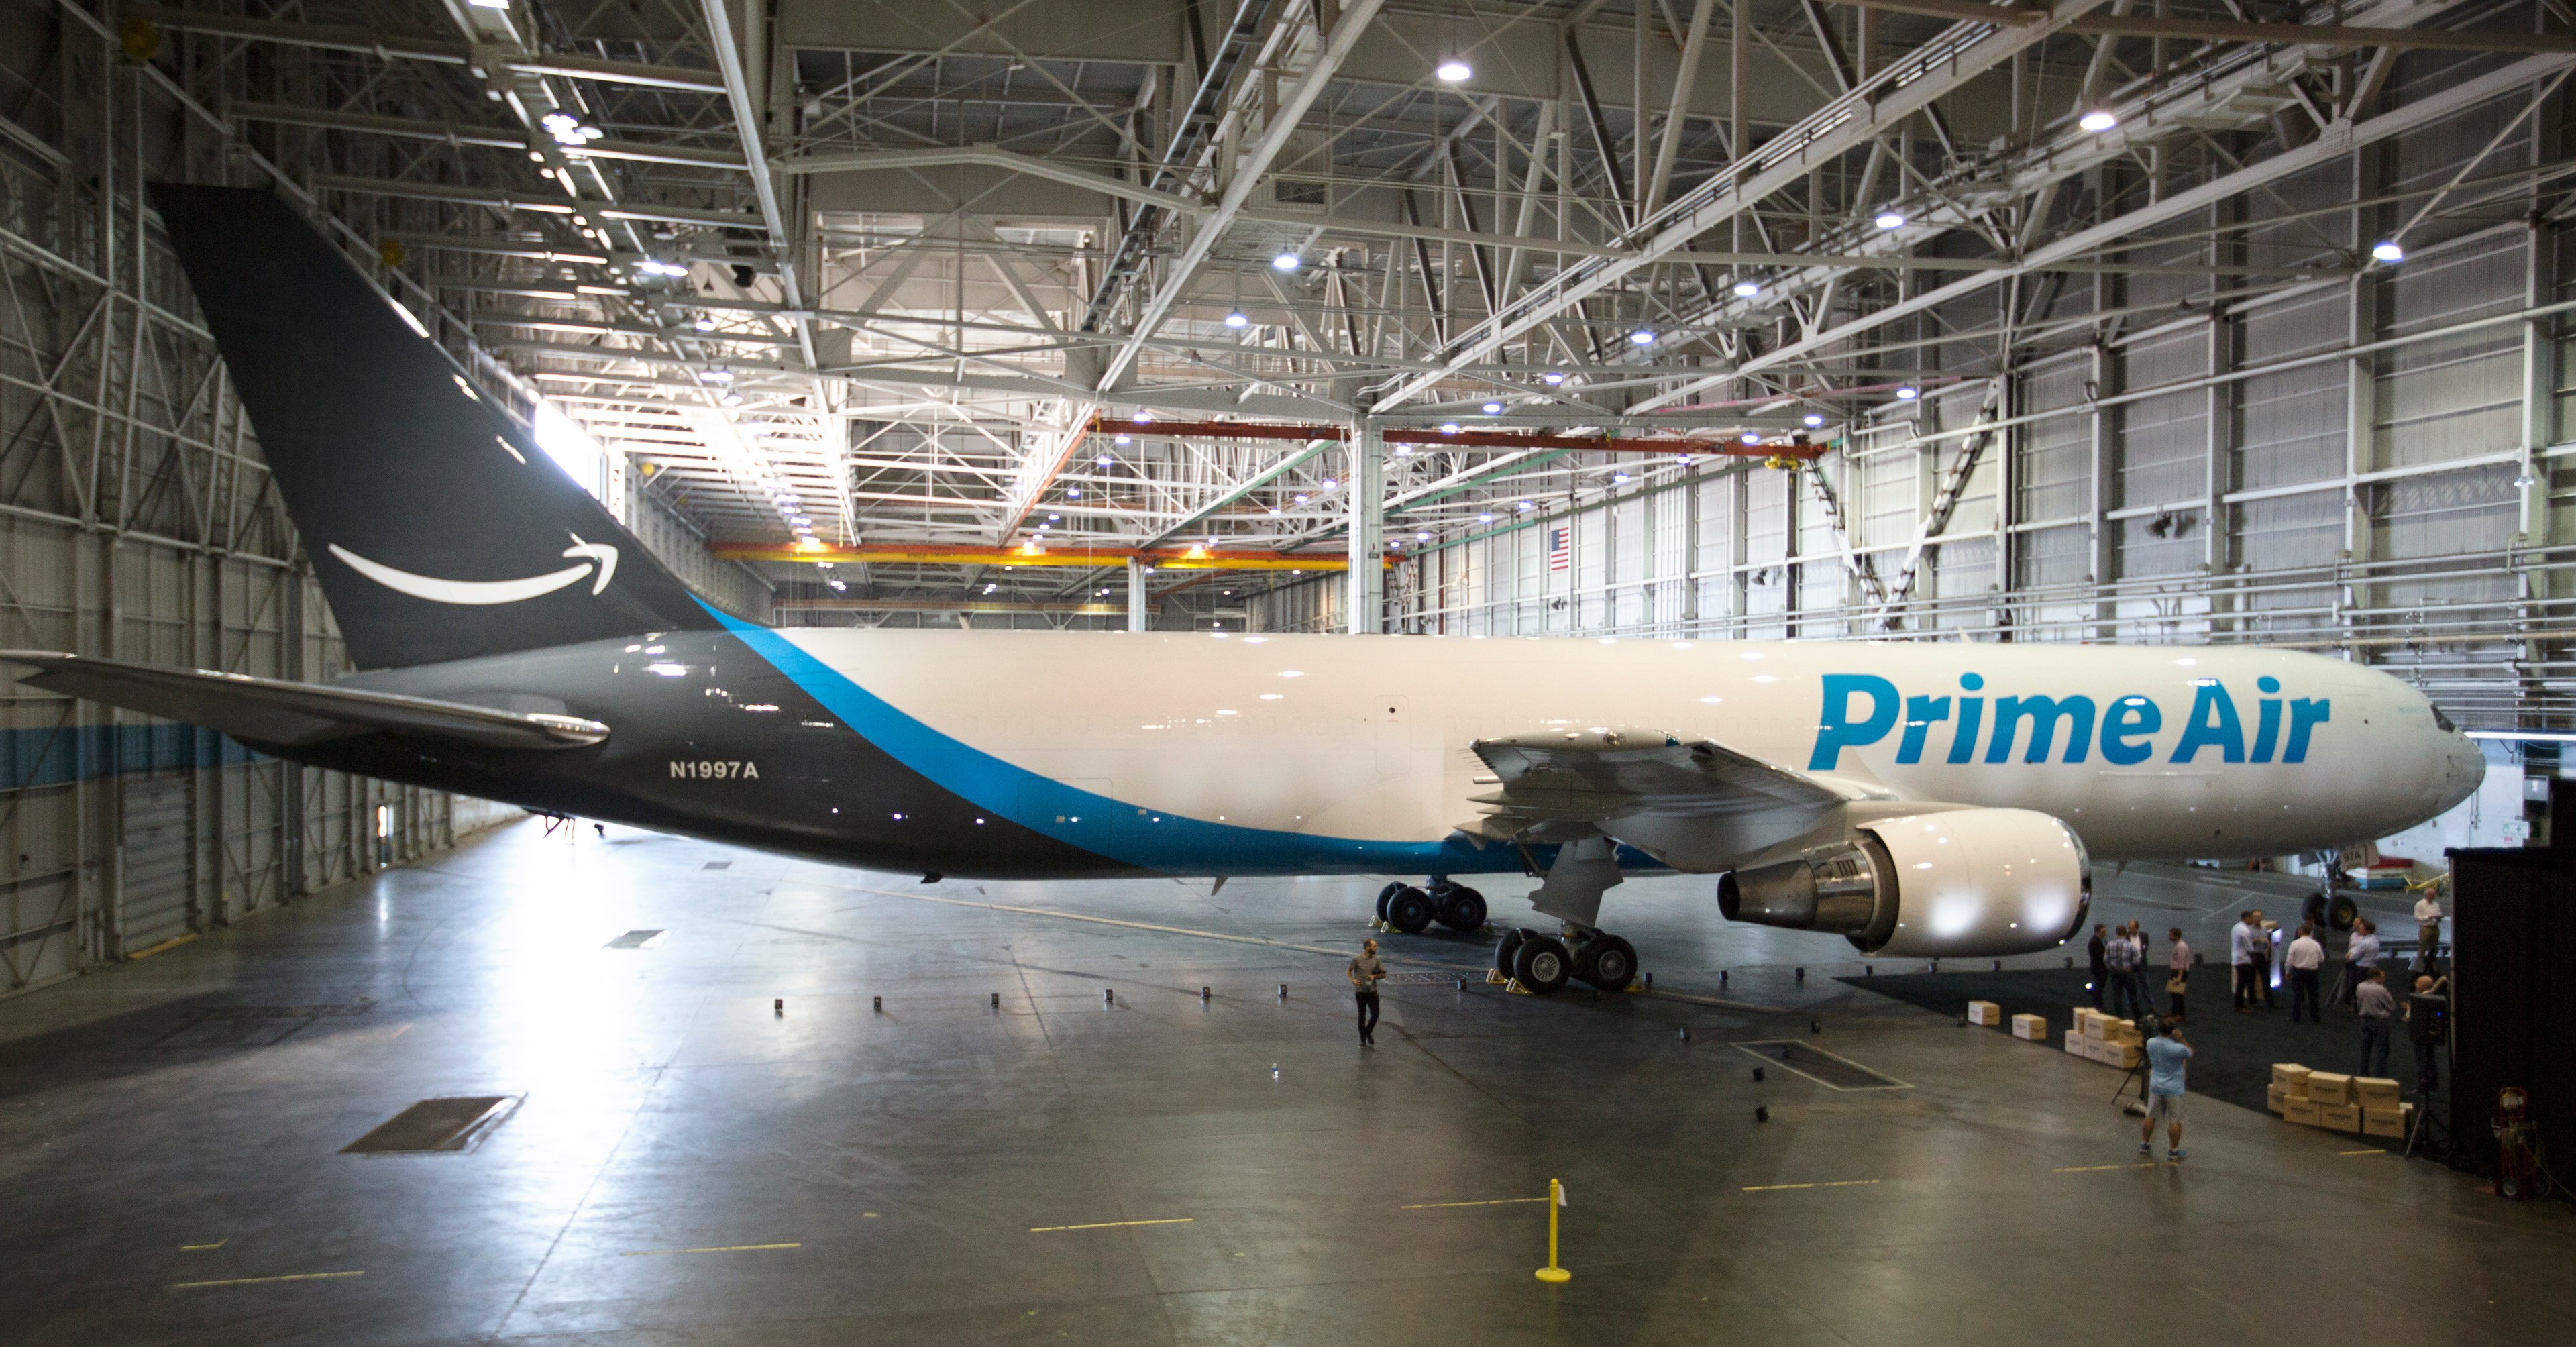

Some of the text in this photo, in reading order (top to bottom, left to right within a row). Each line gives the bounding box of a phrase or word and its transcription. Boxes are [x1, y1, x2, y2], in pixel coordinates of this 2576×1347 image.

[1808, 673, 2330, 771] Prime Air
[669, 761, 759, 779] N1997A
